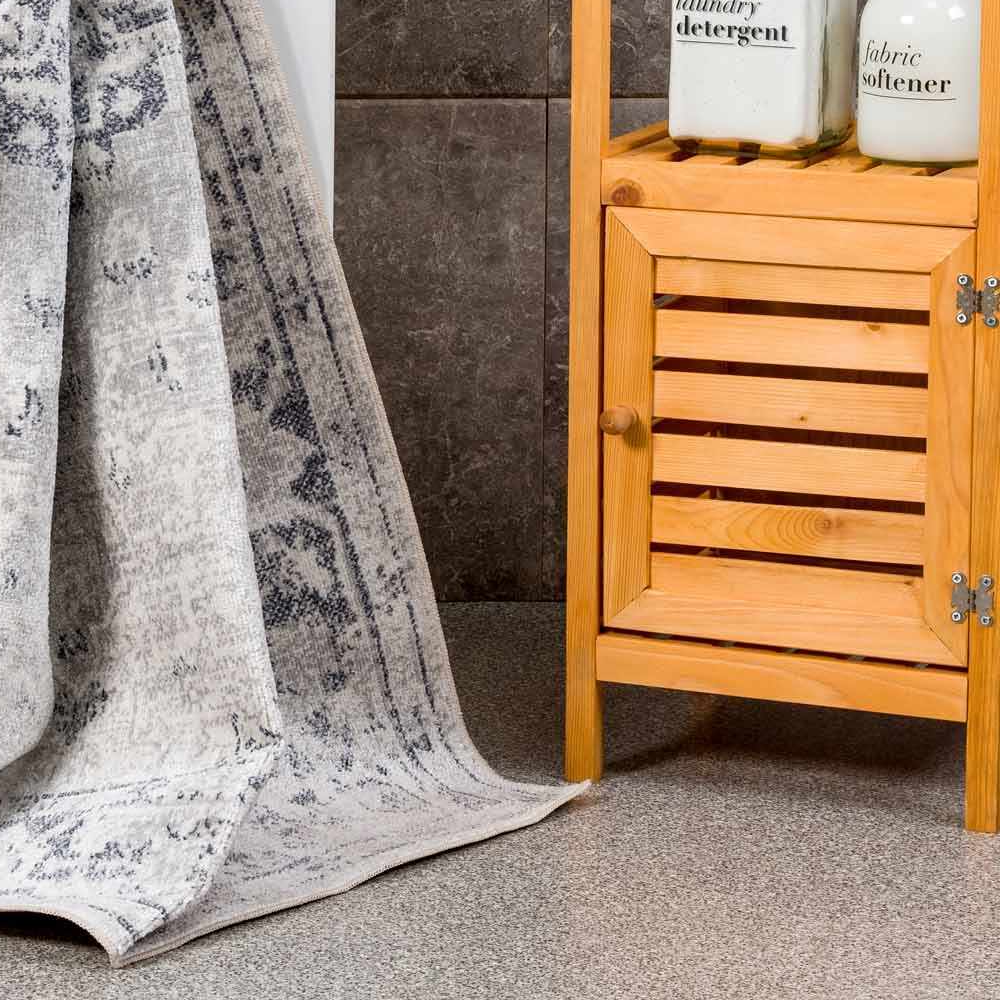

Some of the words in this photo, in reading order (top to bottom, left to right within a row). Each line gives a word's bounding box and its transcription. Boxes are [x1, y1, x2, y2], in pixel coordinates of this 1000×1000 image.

[676, 15, 788, 46] detergent
[863, 39, 922, 67] fabric
[862, 68, 952, 94] softener
